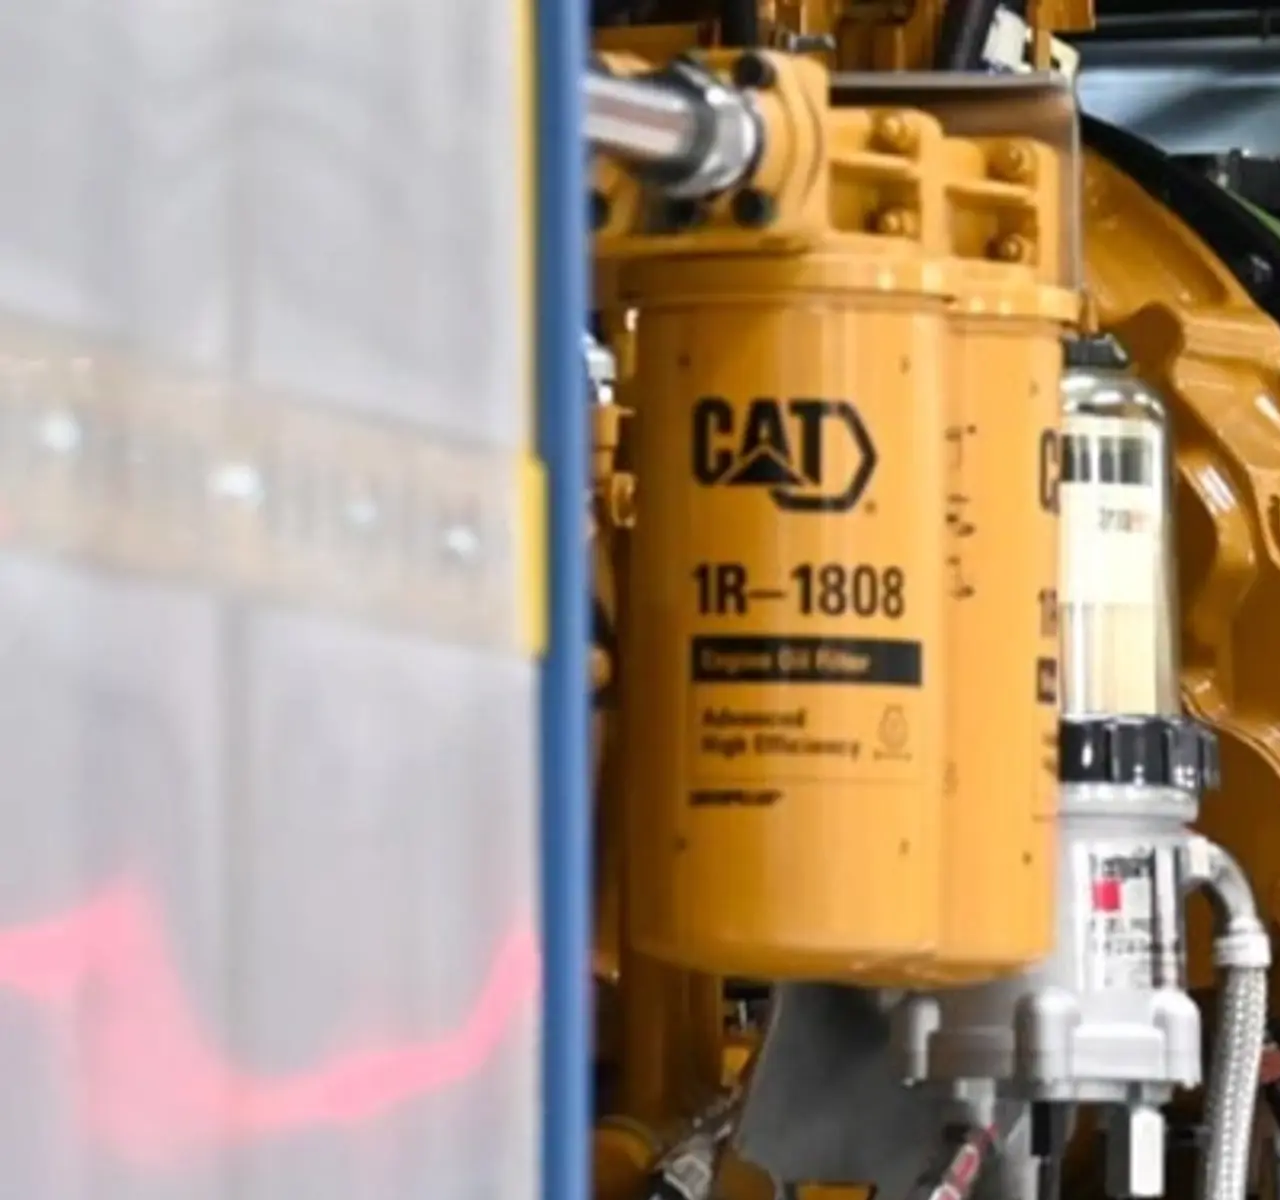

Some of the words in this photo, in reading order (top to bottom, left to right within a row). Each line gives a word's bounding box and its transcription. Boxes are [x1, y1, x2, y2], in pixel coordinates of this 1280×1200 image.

[692, 563, 906, 618] 1R-1808
[702, 706, 806, 728] Advanced
[702, 735, 747, 760] High
[753, 733, 861, 761] Efficiency
